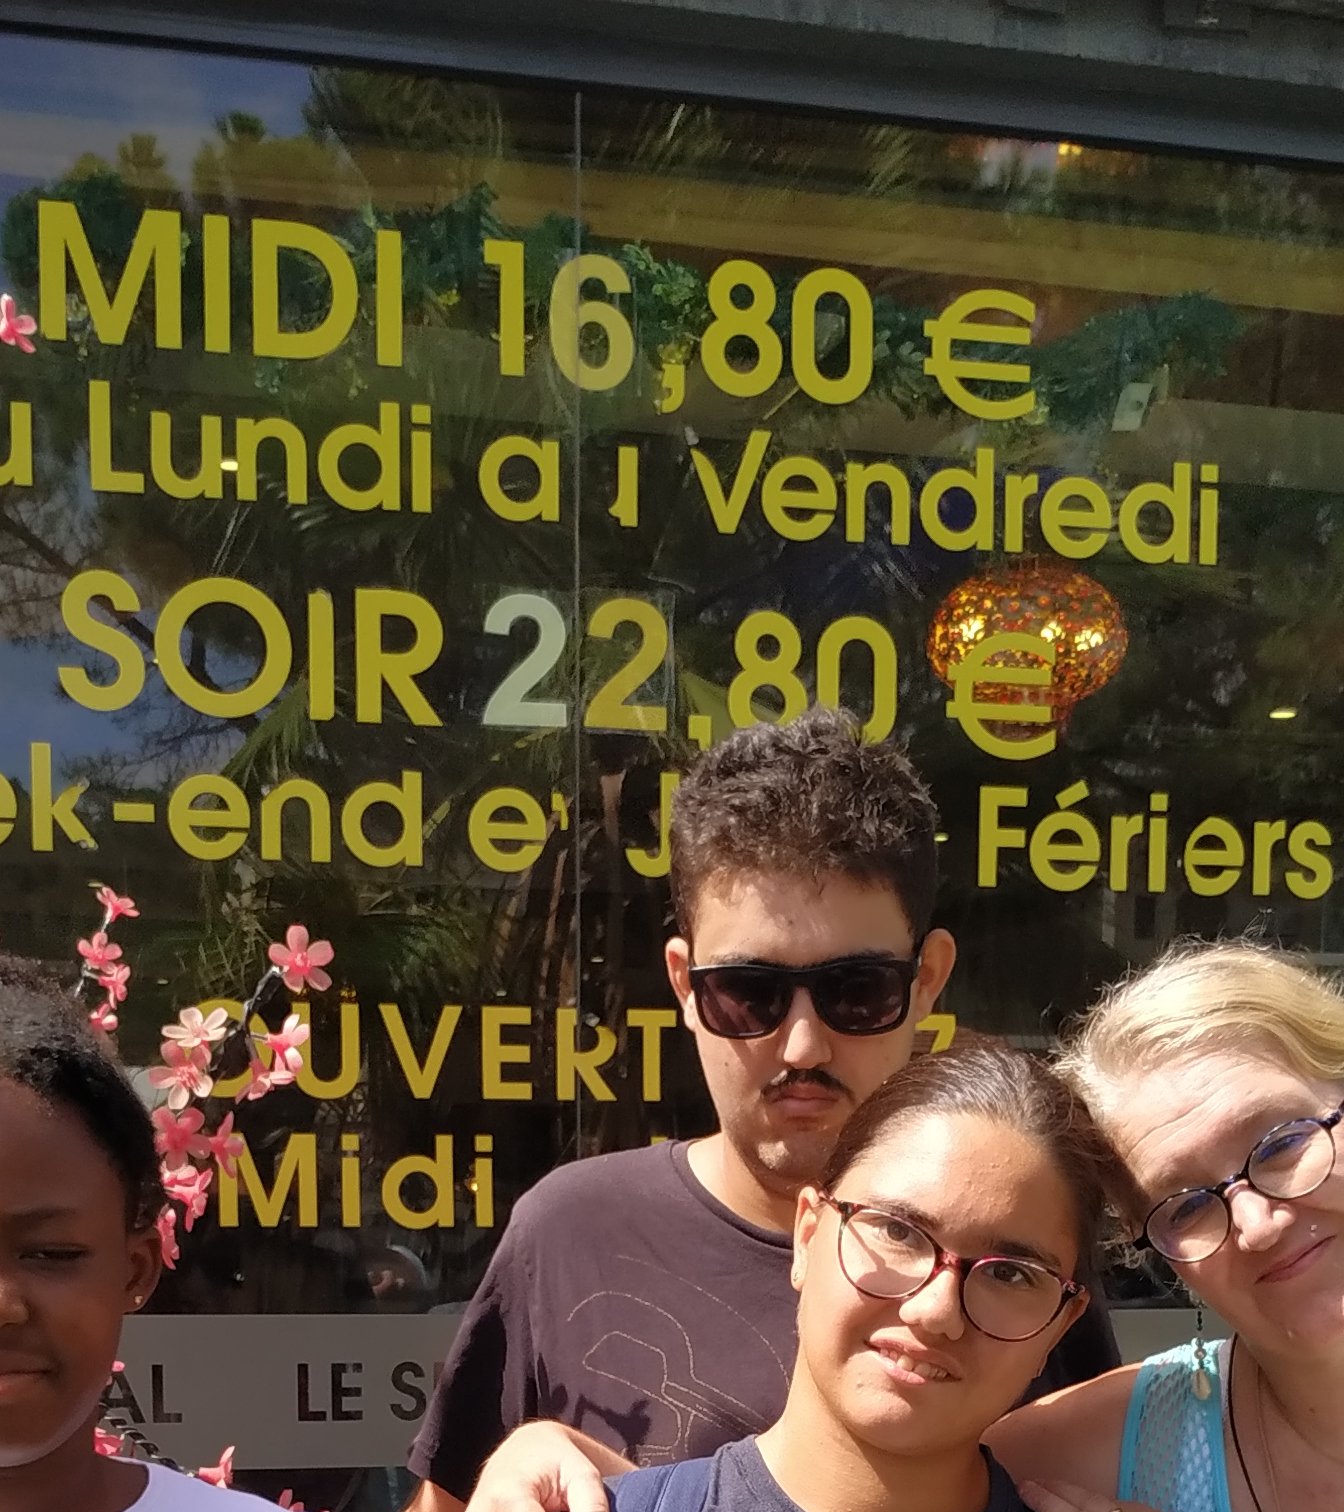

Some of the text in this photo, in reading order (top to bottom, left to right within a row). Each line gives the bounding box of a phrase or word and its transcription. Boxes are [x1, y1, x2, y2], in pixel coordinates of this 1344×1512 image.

[37, 199, 1037, 421] MIDI 16,80 €
[88, 379, 433, 514] Lundi
[690, 429, 1220, 566] Vendredi
[59, 569, 1057, 761] SOIR 22,80 €
[977, 780, 1334, 900] Fériers
[180, 998, 679, 1102] OUVERT
[218, 1132, 495, 1230] Midi
[296, 1361, 364, 1422] LE
